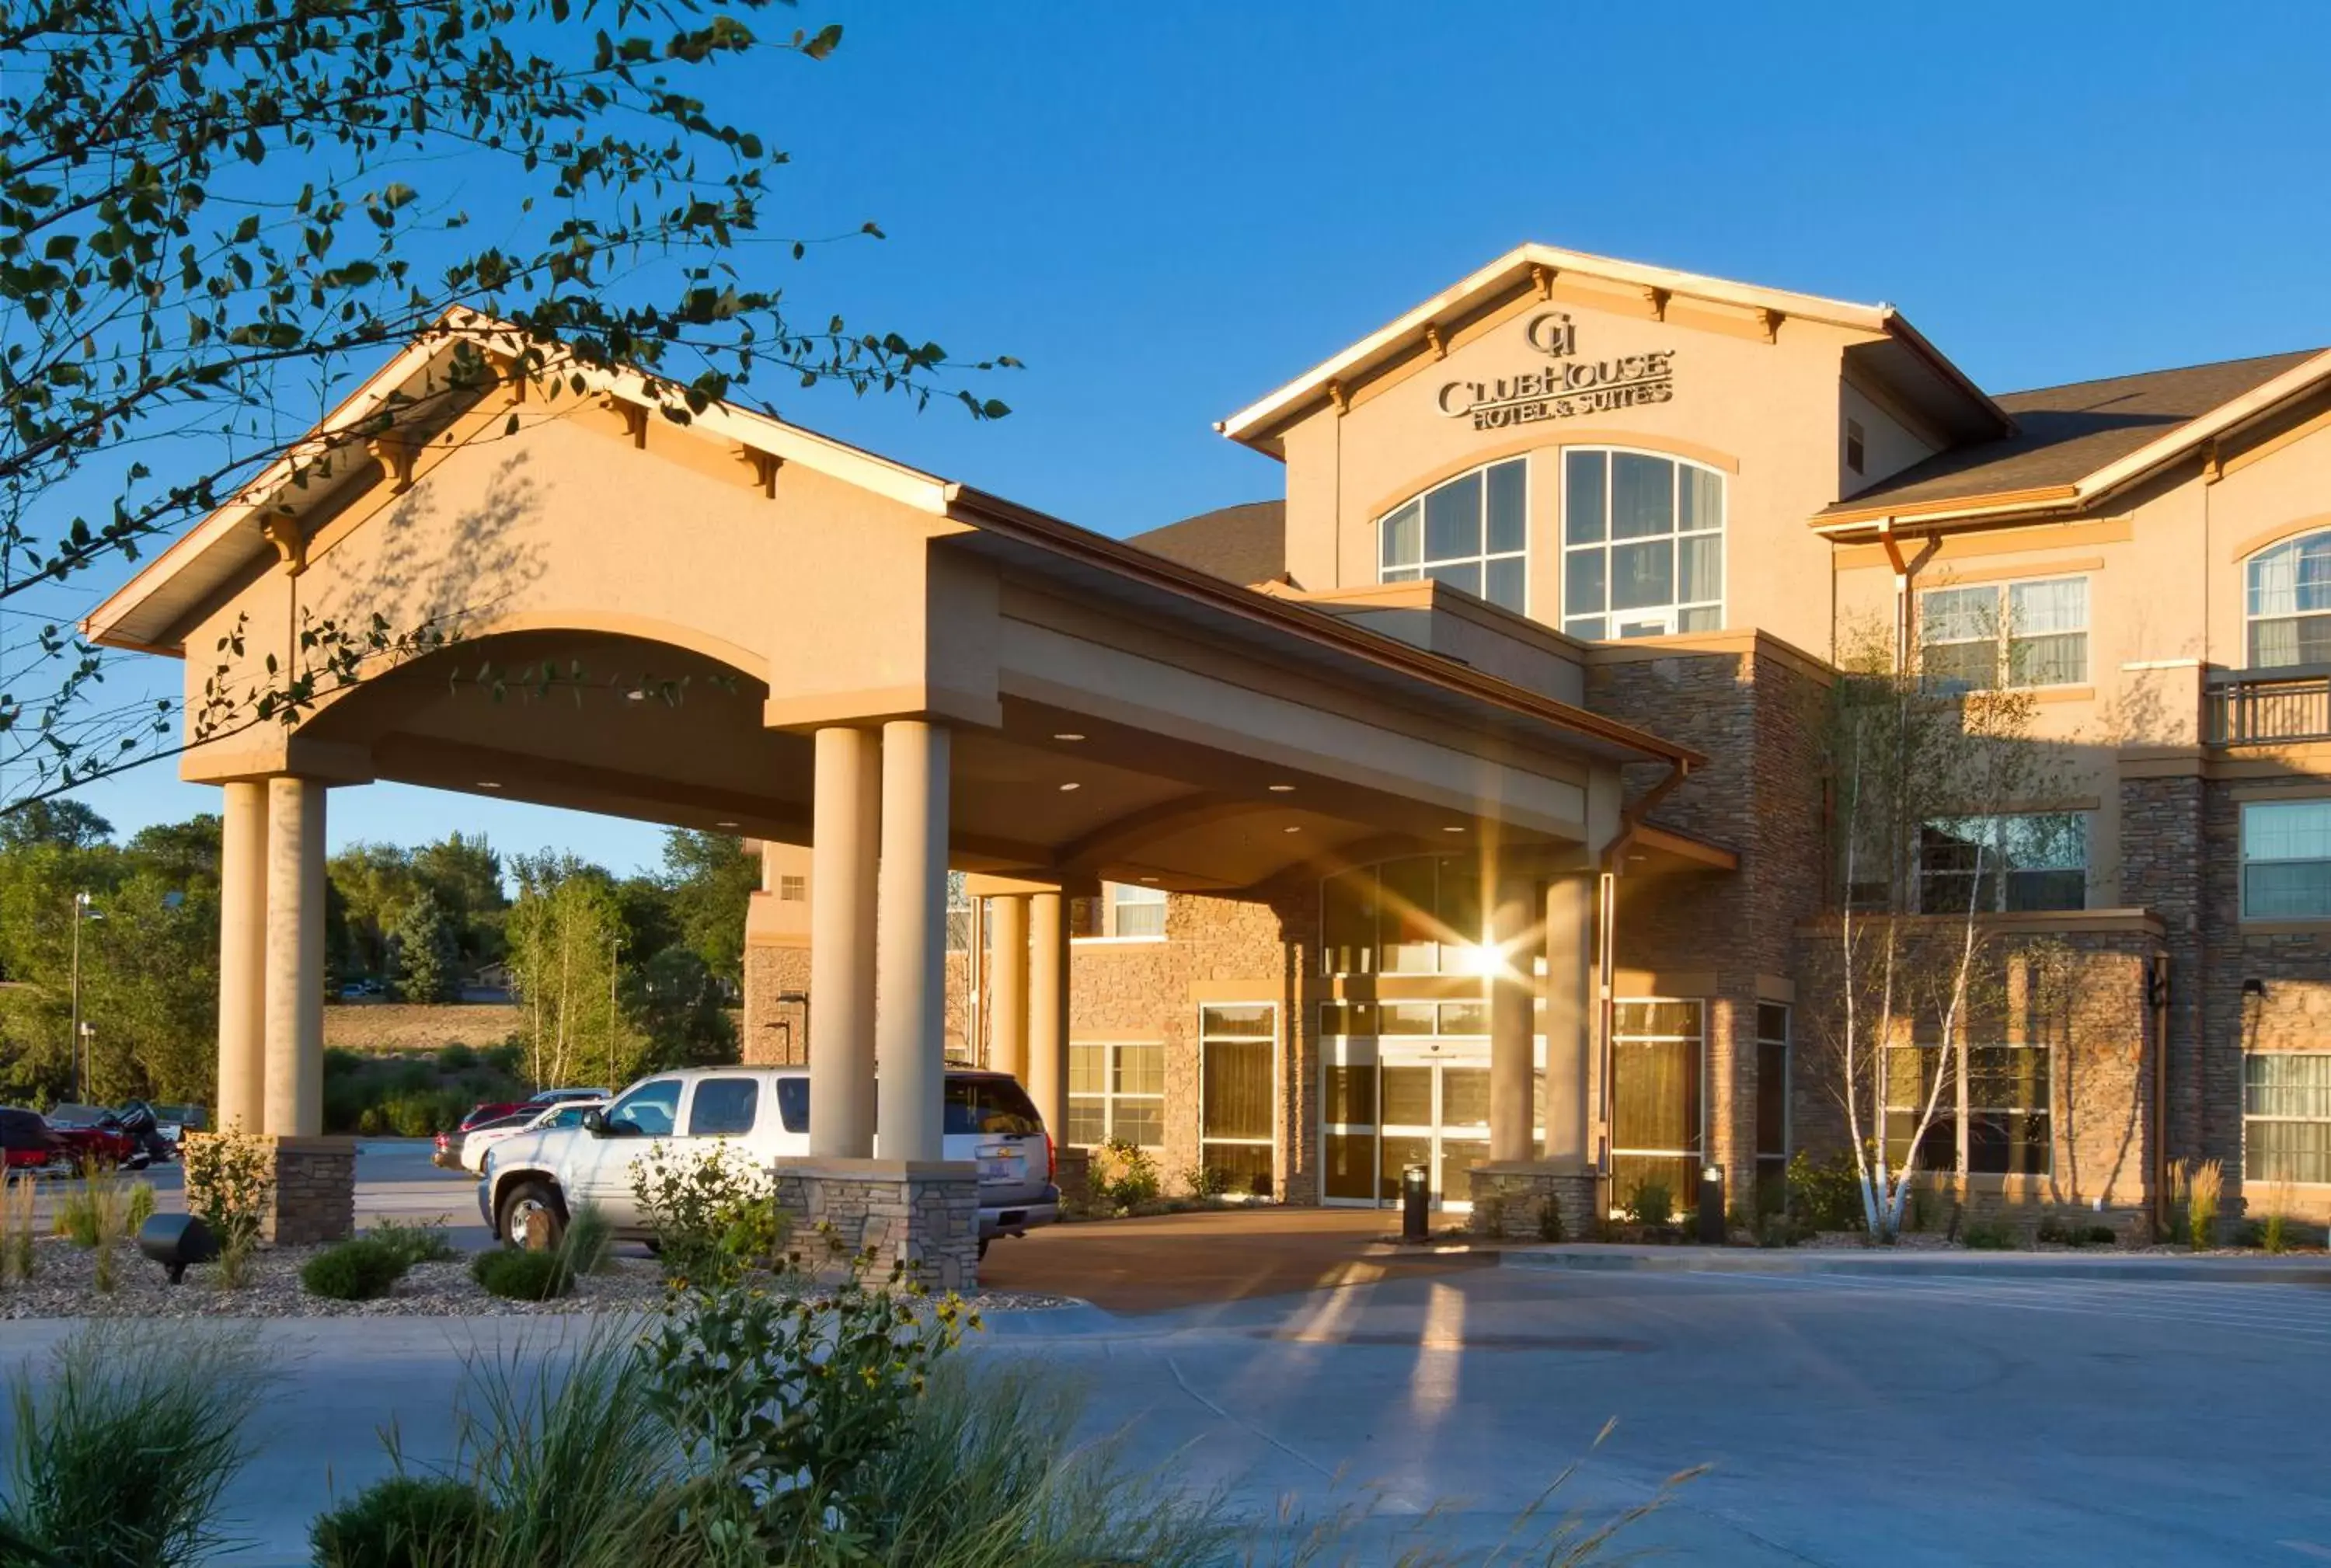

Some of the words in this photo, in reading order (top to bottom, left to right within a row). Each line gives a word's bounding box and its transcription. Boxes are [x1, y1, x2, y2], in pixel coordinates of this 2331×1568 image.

[1437, 350, 1674, 418] CLUBHOUSE
[1473, 402, 1555, 431] HOTEL
[1556, 399, 1575, 417] &
[1579, 382, 1673, 414] SUITES
